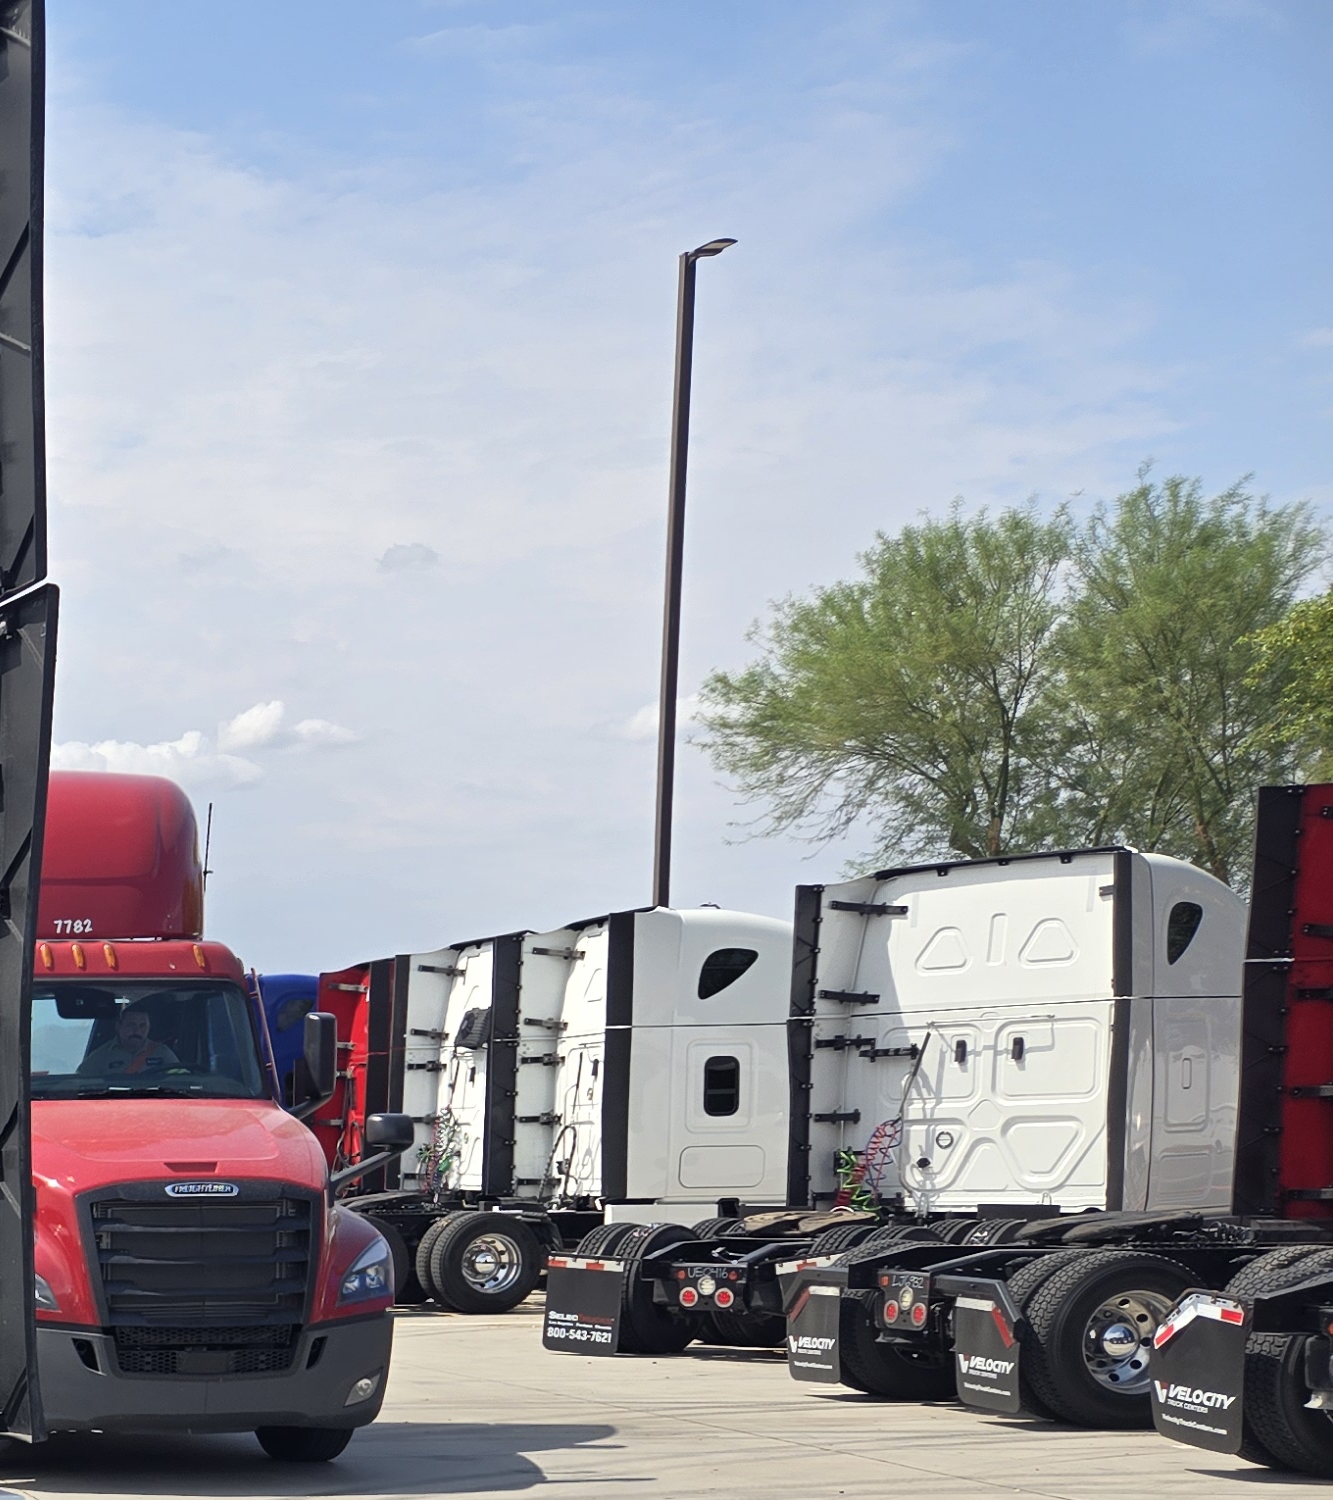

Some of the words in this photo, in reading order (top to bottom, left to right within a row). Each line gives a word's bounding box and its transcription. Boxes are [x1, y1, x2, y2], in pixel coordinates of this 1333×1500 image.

[53, 918, 93, 934] 7782
[547, 1327, 612, 1343] 800-543-7621
[798, 1336, 836, 1350] VELOCITY
[969, 1355, 1015, 1374] VELOCITY
[1168, 1383, 1237, 1410] VELOCITY
